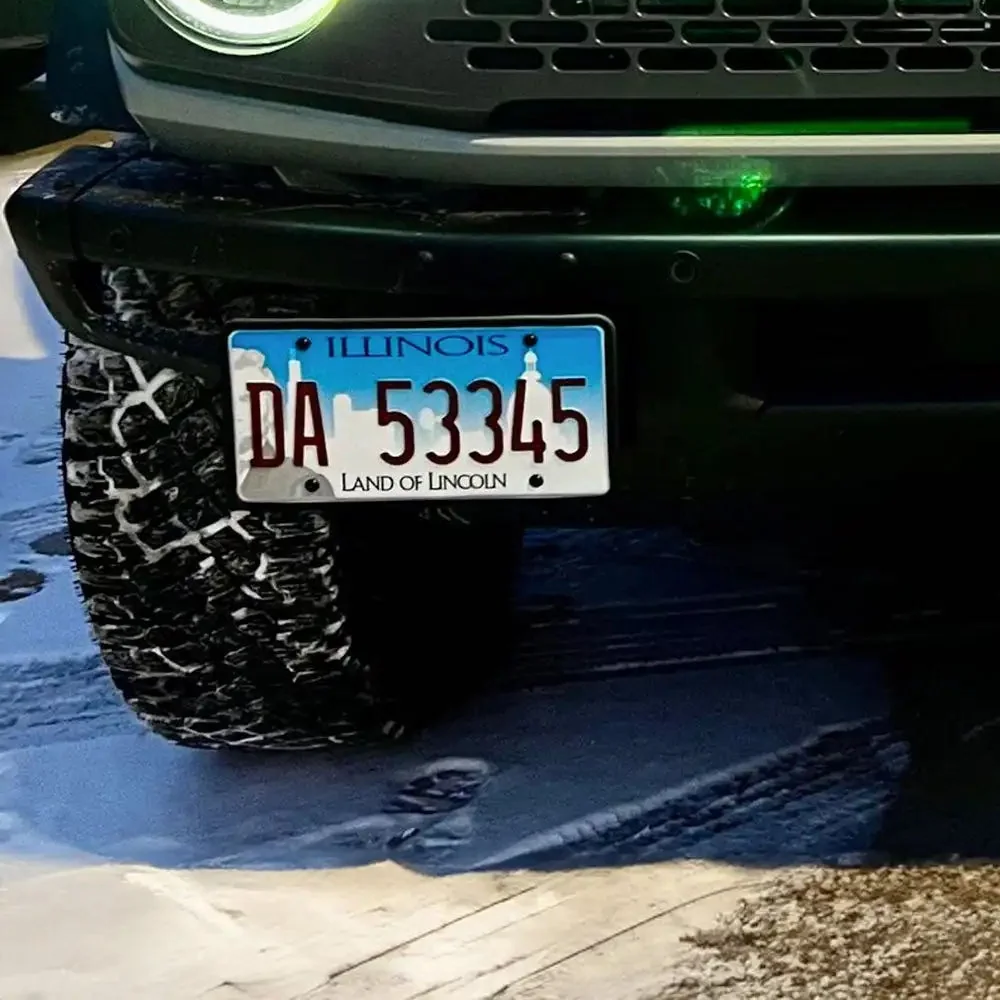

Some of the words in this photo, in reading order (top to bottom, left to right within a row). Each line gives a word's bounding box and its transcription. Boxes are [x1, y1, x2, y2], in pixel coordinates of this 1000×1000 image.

[327, 334, 509, 358] ILLINOIS
[246, 382, 329, 468] DA
[377, 378, 589, 466] 53345
